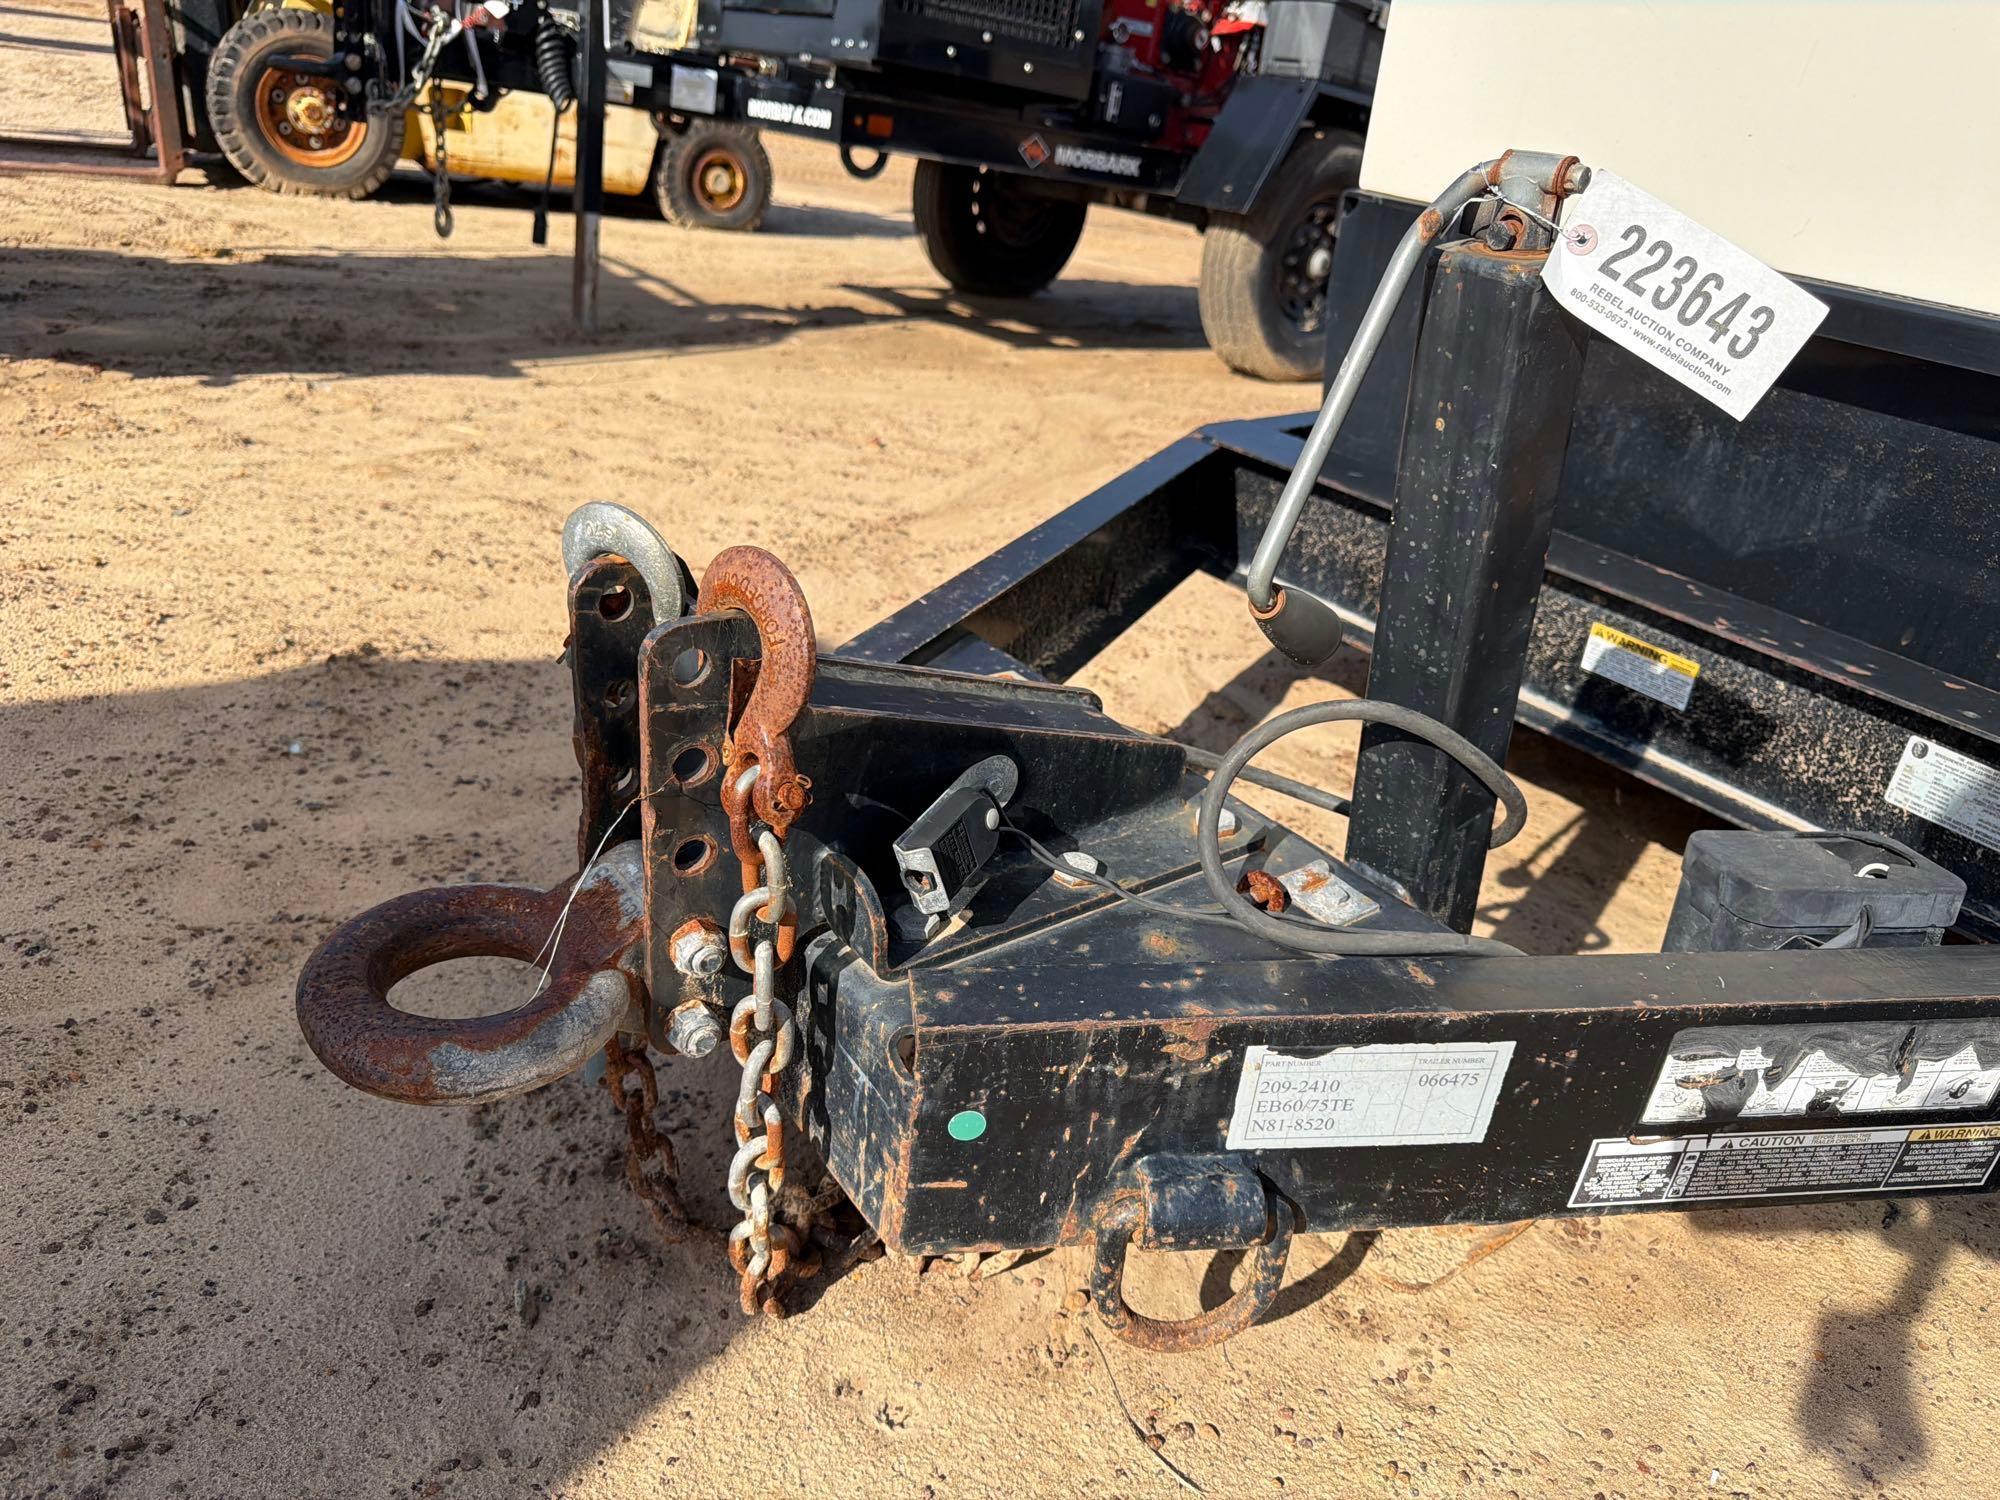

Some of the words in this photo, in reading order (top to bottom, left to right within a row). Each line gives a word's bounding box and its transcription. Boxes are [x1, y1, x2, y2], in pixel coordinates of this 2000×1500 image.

[1054, 144, 1142, 178] MORBARK
[1597, 224, 1775, 360] 223643
[1589, 283, 1623, 310] REBEL
[1626, 305, 1676, 341] AUCTION
[1675, 337, 1731, 377] COMPANY
[1570, 287, 1629, 330] 800-533-0673
[1633, 327, 1732, 396] www.rebelauction.com
[1604, 630, 1668, 664] WARNING
[1259, 1079, 1340, 1093] 209-2410
[1418, 1073, 1480, 1087] 066475
[1256, 1099, 1355, 1113] EB60/75TE
[1252, 1118, 1335, 1132] N81-8520
[1934, 1127, 2000, 1139] WARNING
[1739, 1136, 1806, 1147] CAUTION
